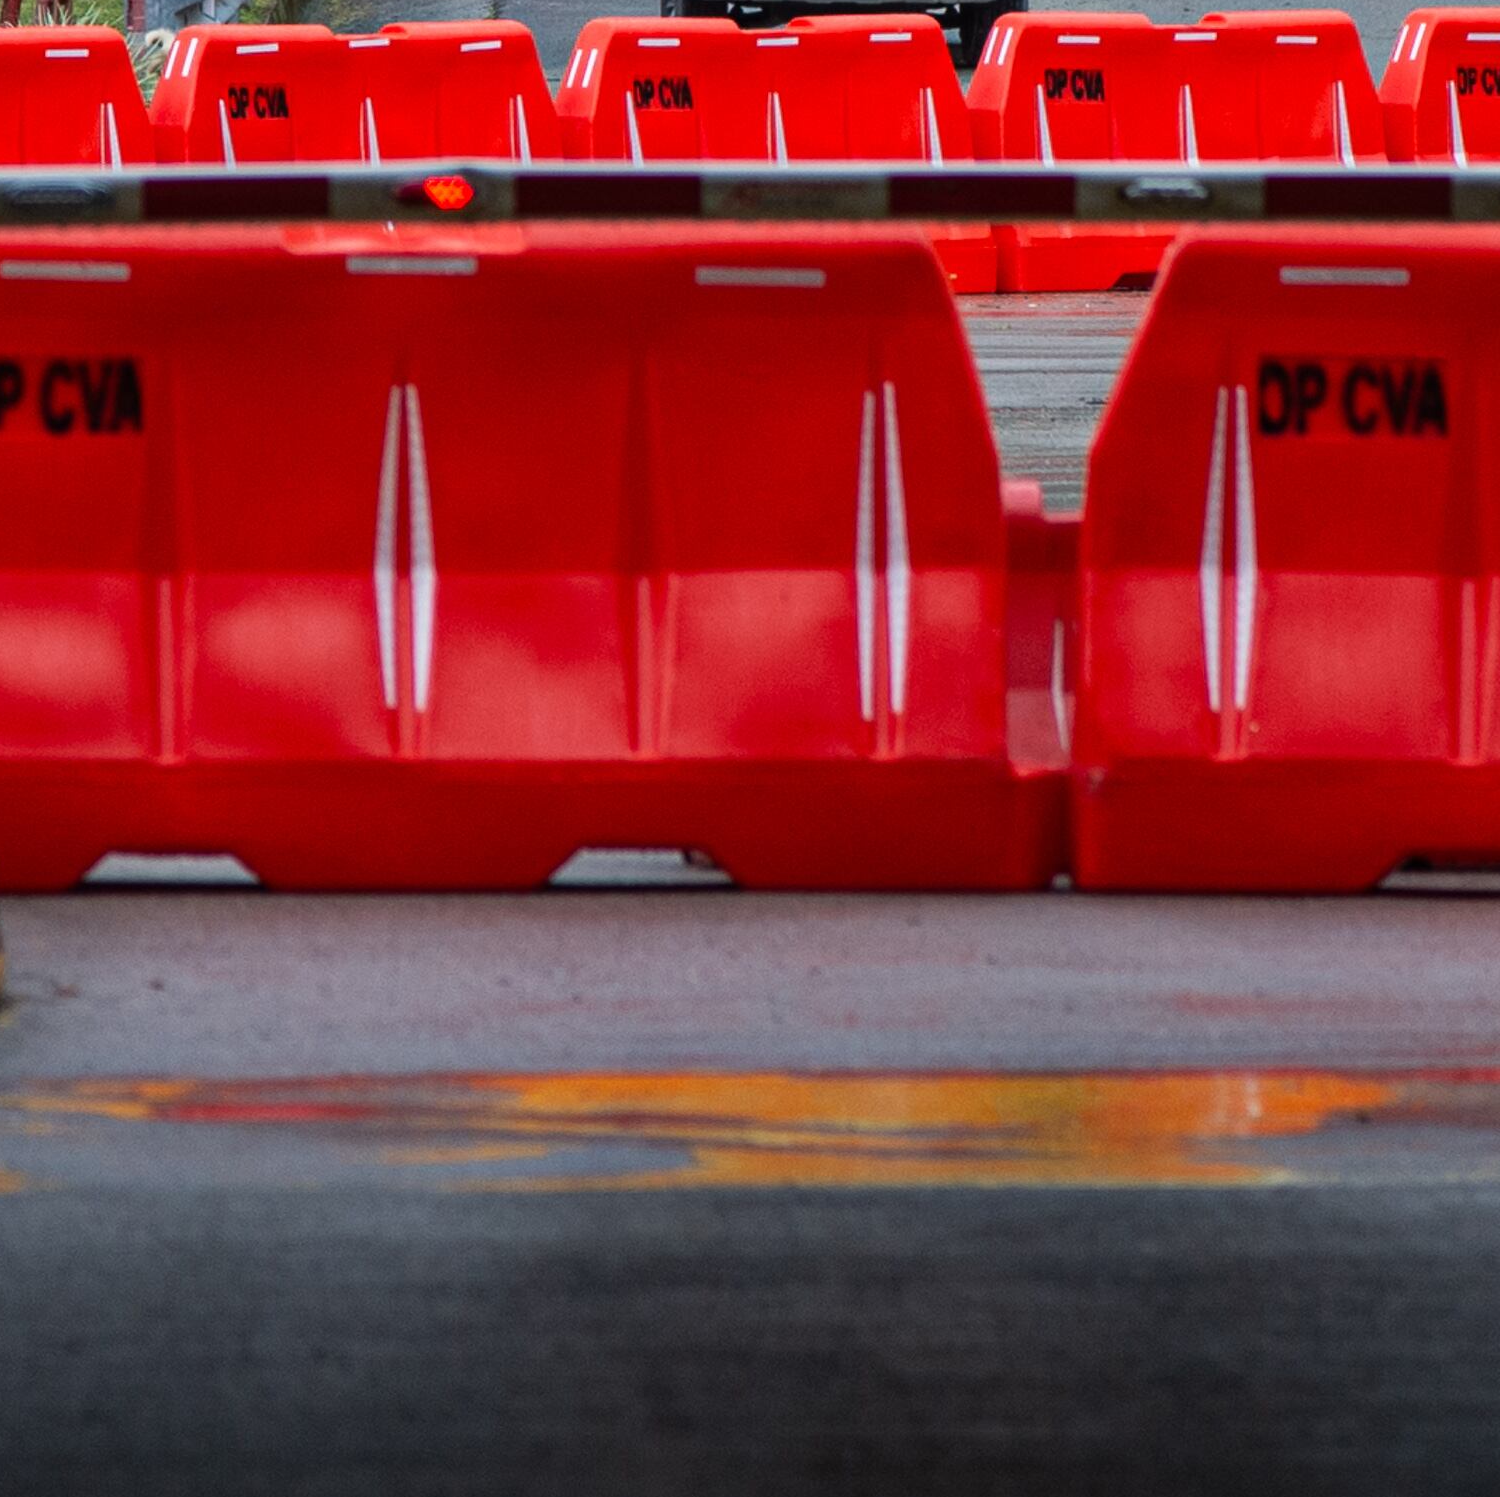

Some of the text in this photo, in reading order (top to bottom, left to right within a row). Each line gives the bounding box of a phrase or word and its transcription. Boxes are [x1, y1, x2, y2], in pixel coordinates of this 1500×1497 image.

[633, 75, 693, 110] DP CVA
[1071, 69, 1105, 101] CVA
[41, 359, 142, 434] CVA
[1258, 360, 1448, 437] DP CVA
